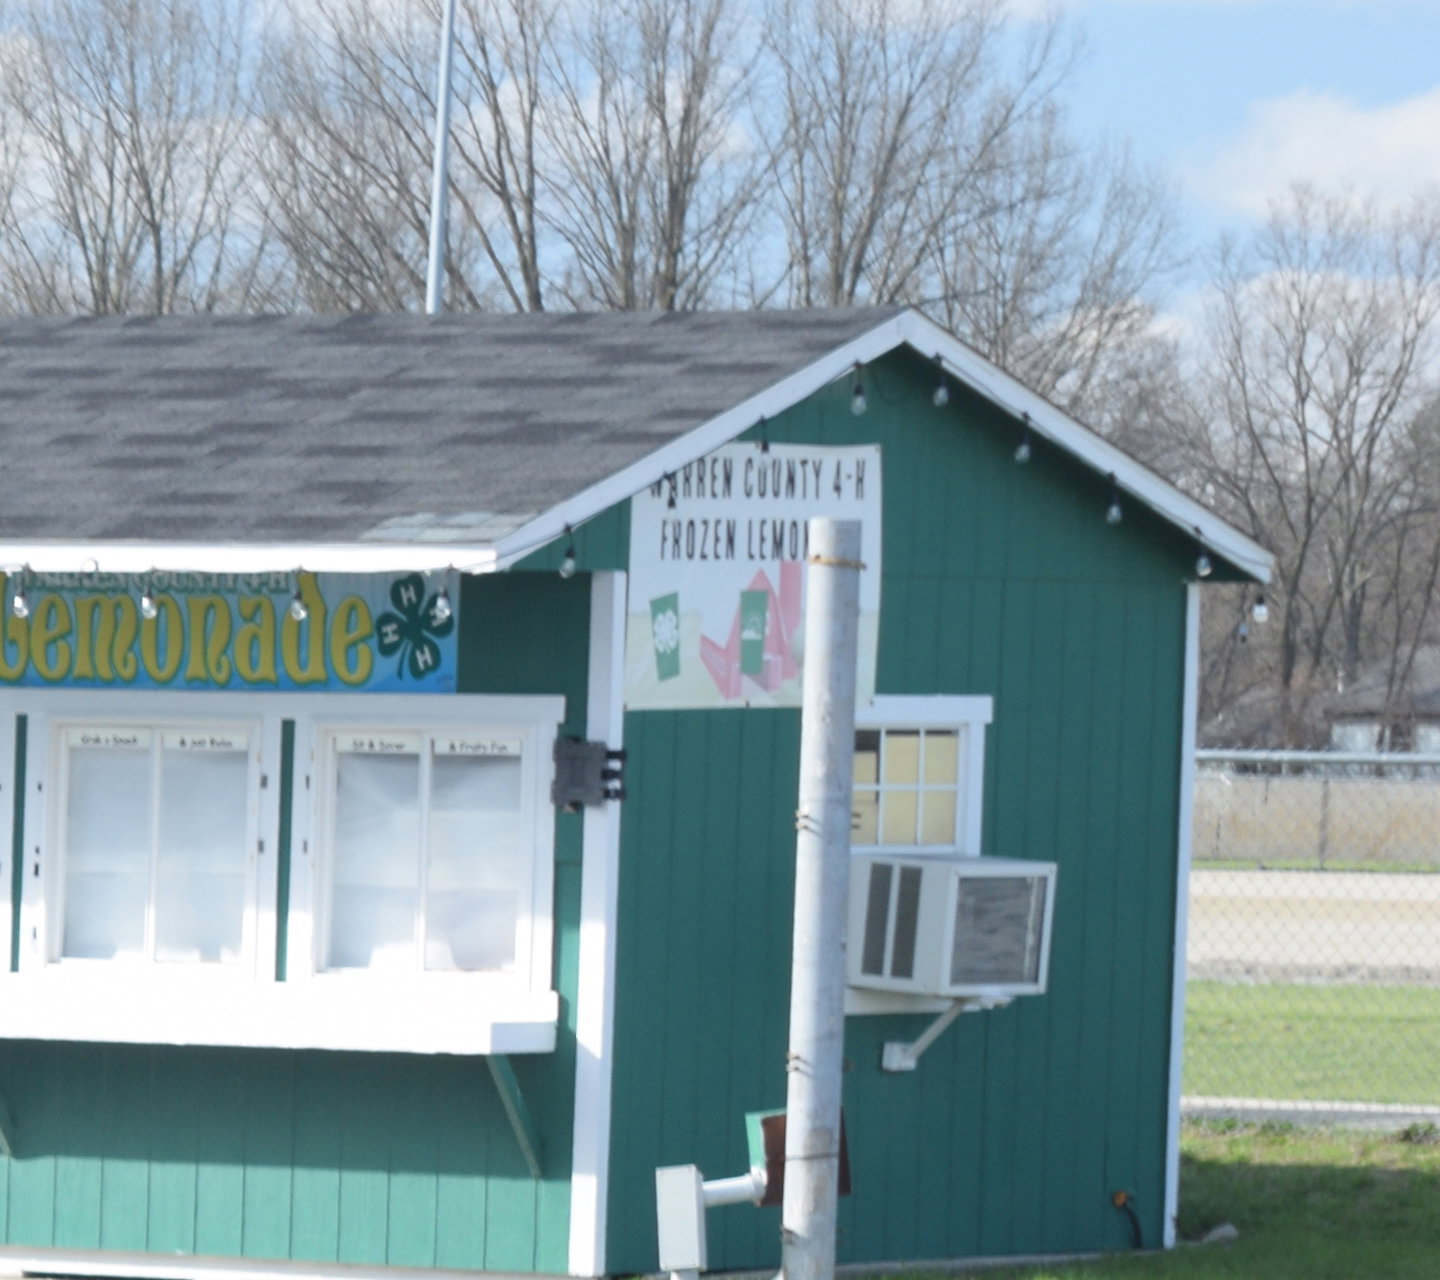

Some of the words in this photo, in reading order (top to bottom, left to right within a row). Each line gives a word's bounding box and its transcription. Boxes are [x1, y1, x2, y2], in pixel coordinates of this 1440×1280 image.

[743, 457, 822, 499] COUNTY
[832, 459, 866, 499] 4-H
[660, 518, 736, 560] FROZEN
